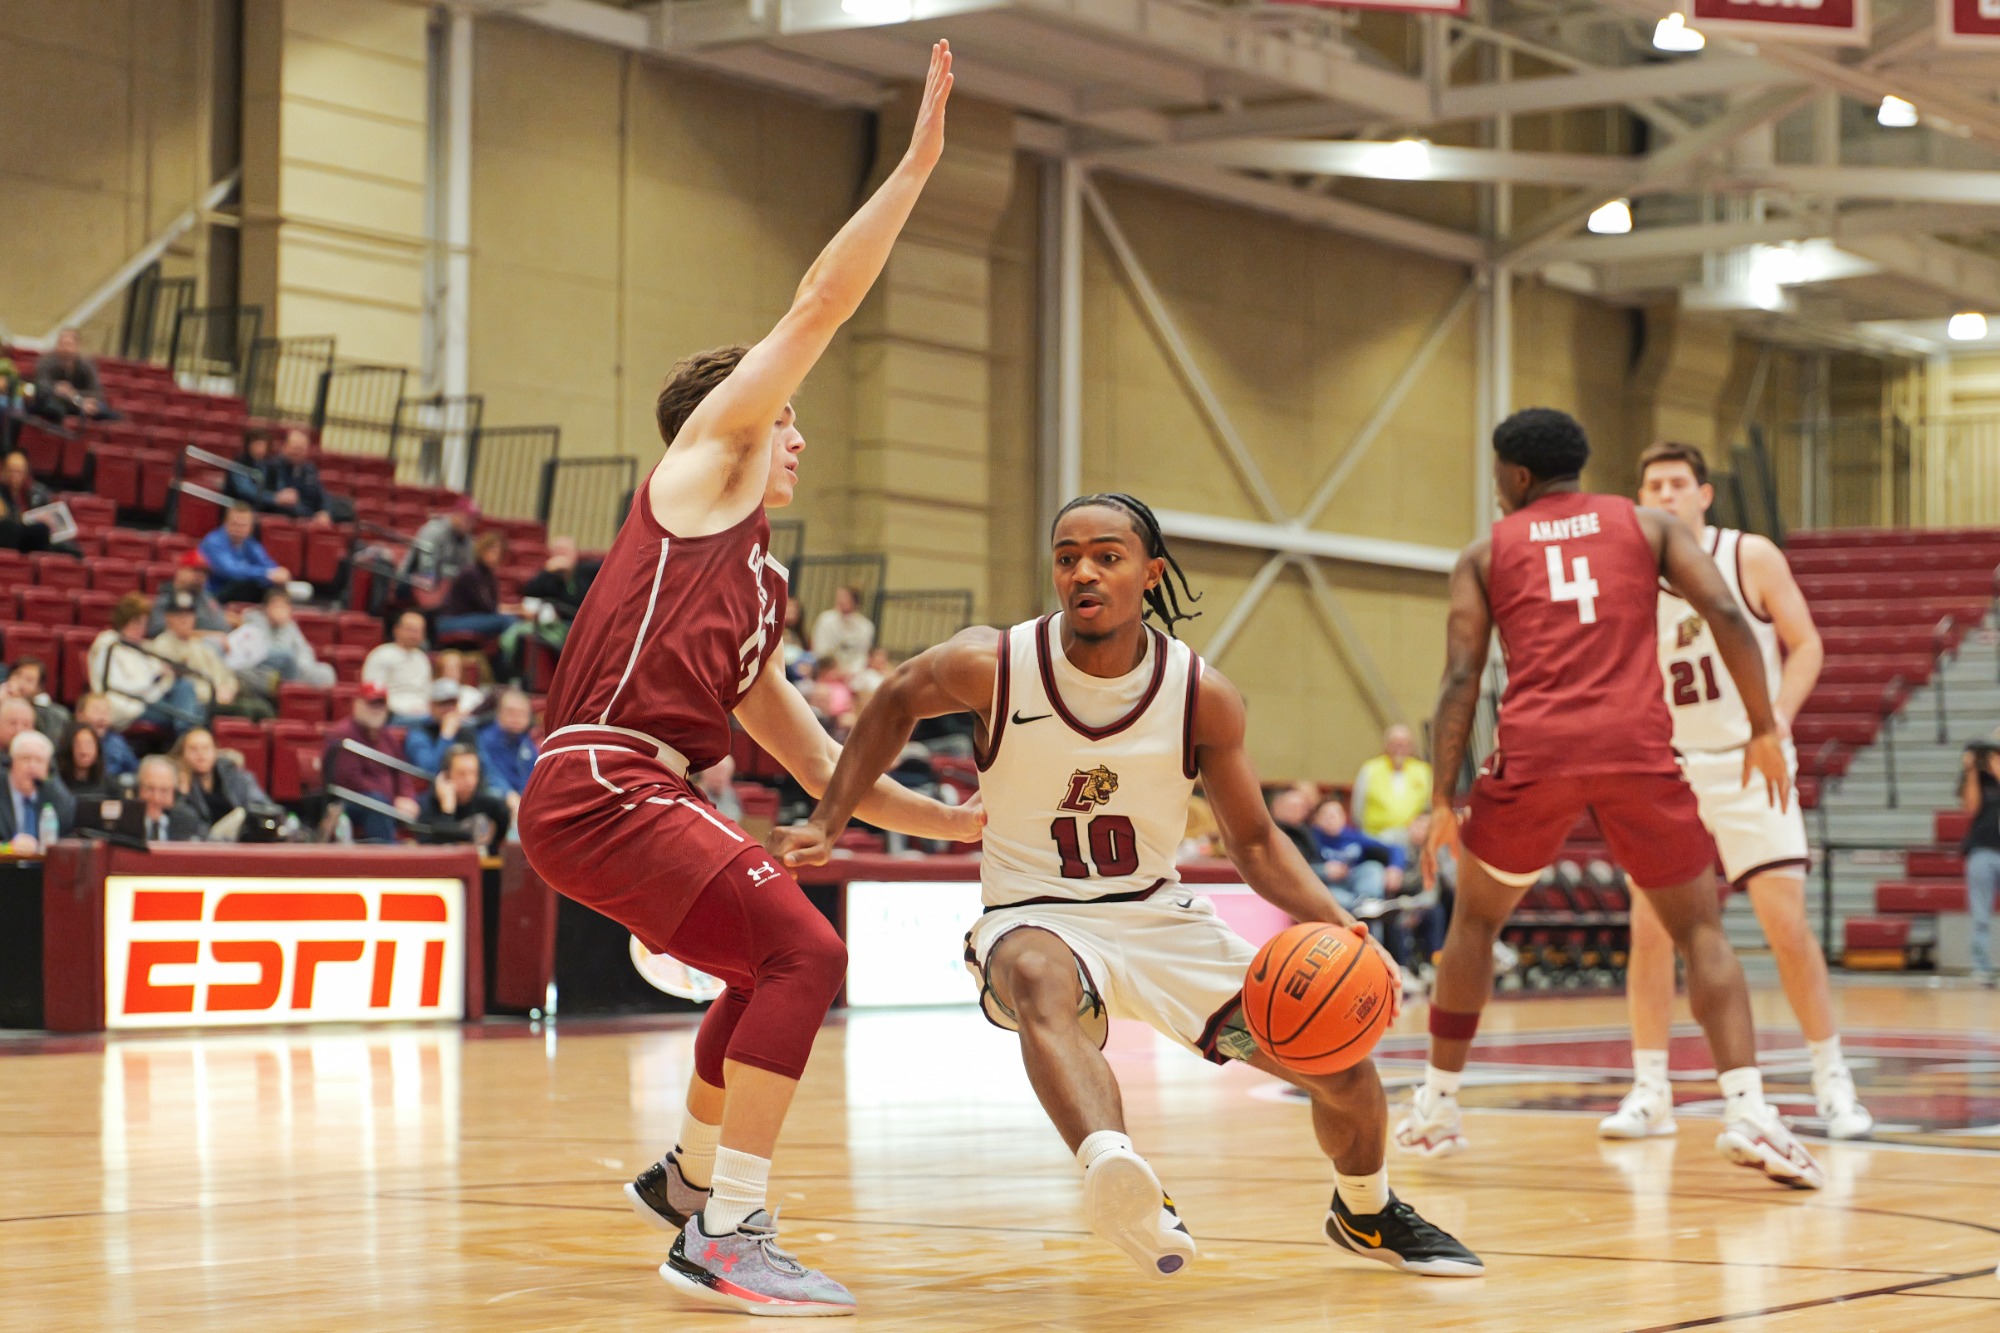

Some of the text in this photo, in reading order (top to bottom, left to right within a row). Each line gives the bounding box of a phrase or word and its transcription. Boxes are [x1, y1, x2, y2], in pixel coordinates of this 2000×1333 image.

[1545, 545, 1599, 624] 4
[1670, 655, 1720, 706] 21
[1057, 773, 1097, 814] L
[1050, 814, 1139, 879] 10
[122, 890, 447, 1014] ESPN
[1284, 935, 1343, 1001] ELITE
